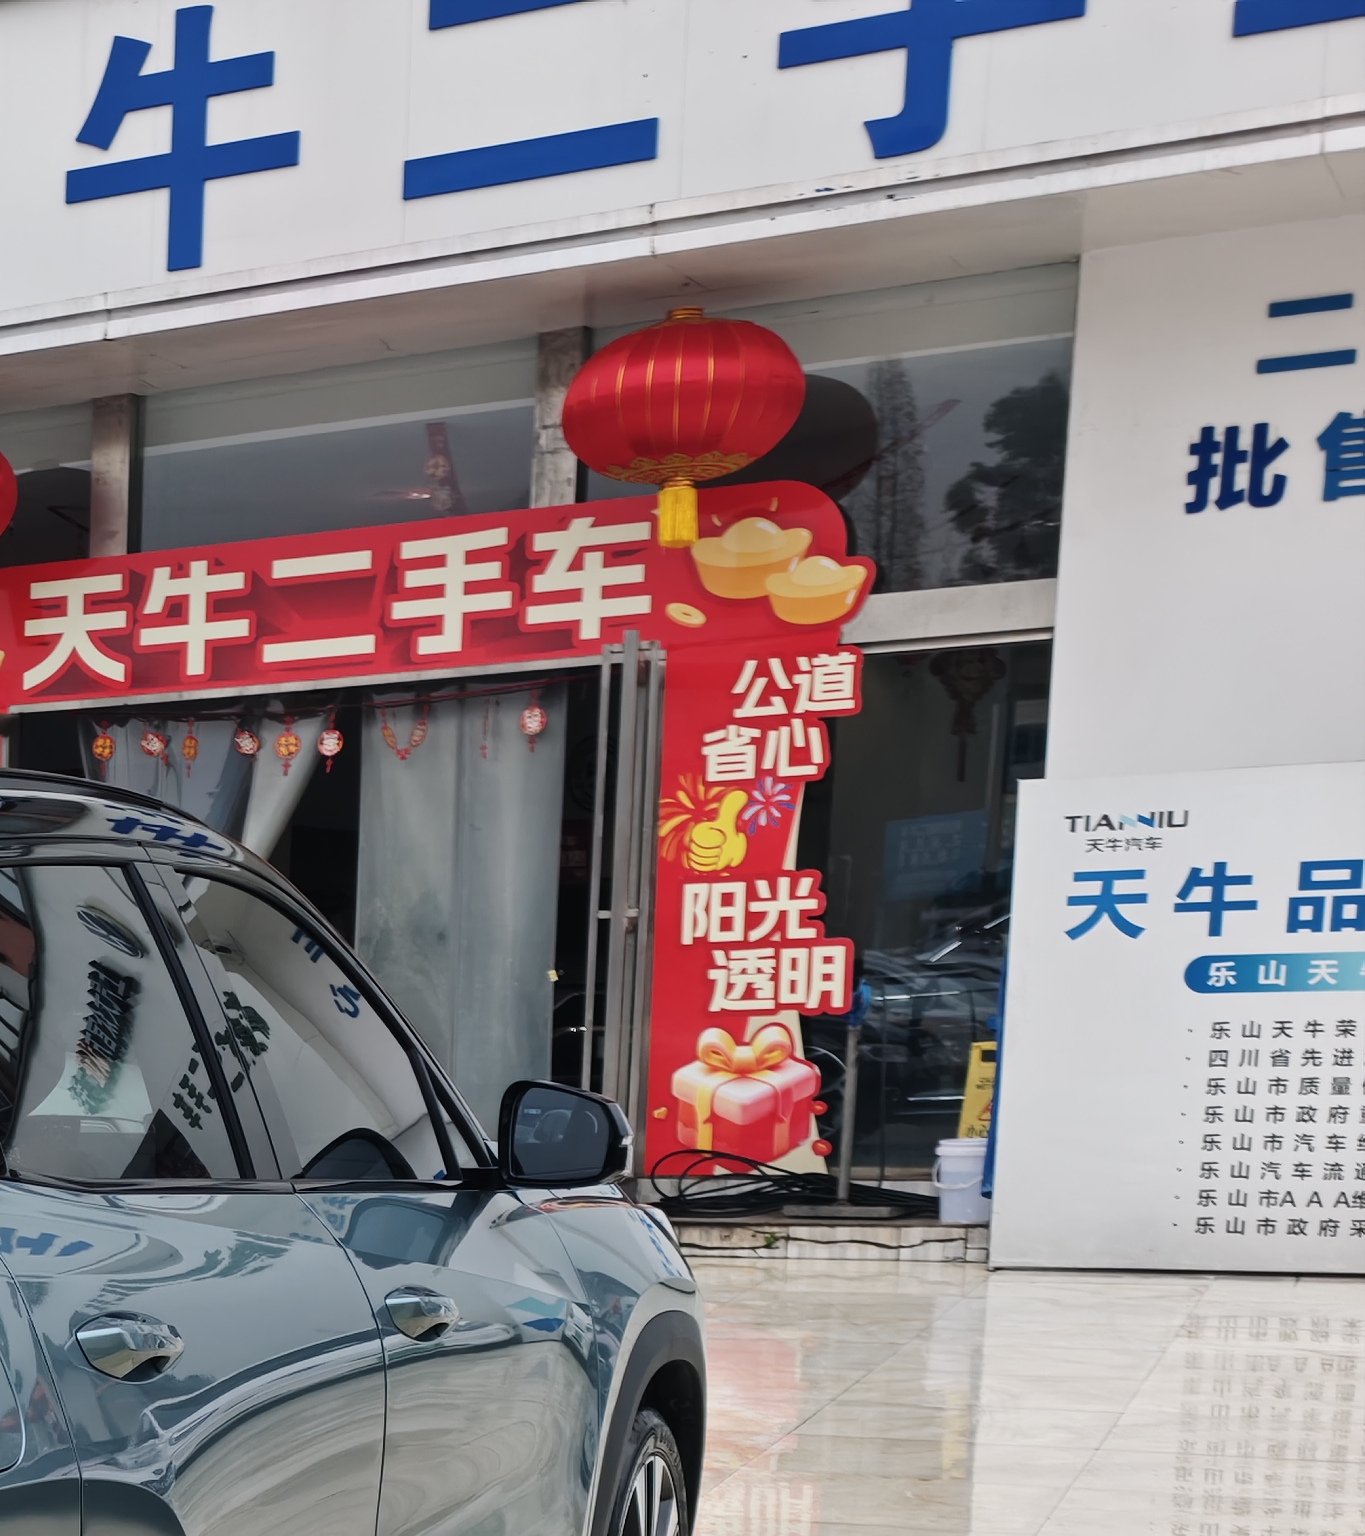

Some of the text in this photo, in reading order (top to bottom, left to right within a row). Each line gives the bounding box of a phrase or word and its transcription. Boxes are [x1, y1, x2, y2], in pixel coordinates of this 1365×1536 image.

[23, 517, 653, 691] 天牛二手车
[732, 652, 858, 718] 公道
[701, 717, 825, 783] 省心
[1084, 836, 1164, 853] 天牛汽车
[681, 876, 818, 946] 阳光
[1064, 860, 1365, 940] 天牛品
[707, 945, 846, 1012] 透明
[1206, 959, 1365, 987] 乐山天
[1209, 1019, 1357, 1040] 乐山天牛荣
[1207, 1048, 1355, 1068] 四川省先进
[1204, 1076, 1365, 1096] 乐山市质量
[1202, 1104, 1365, 1125] 乐山市政府
